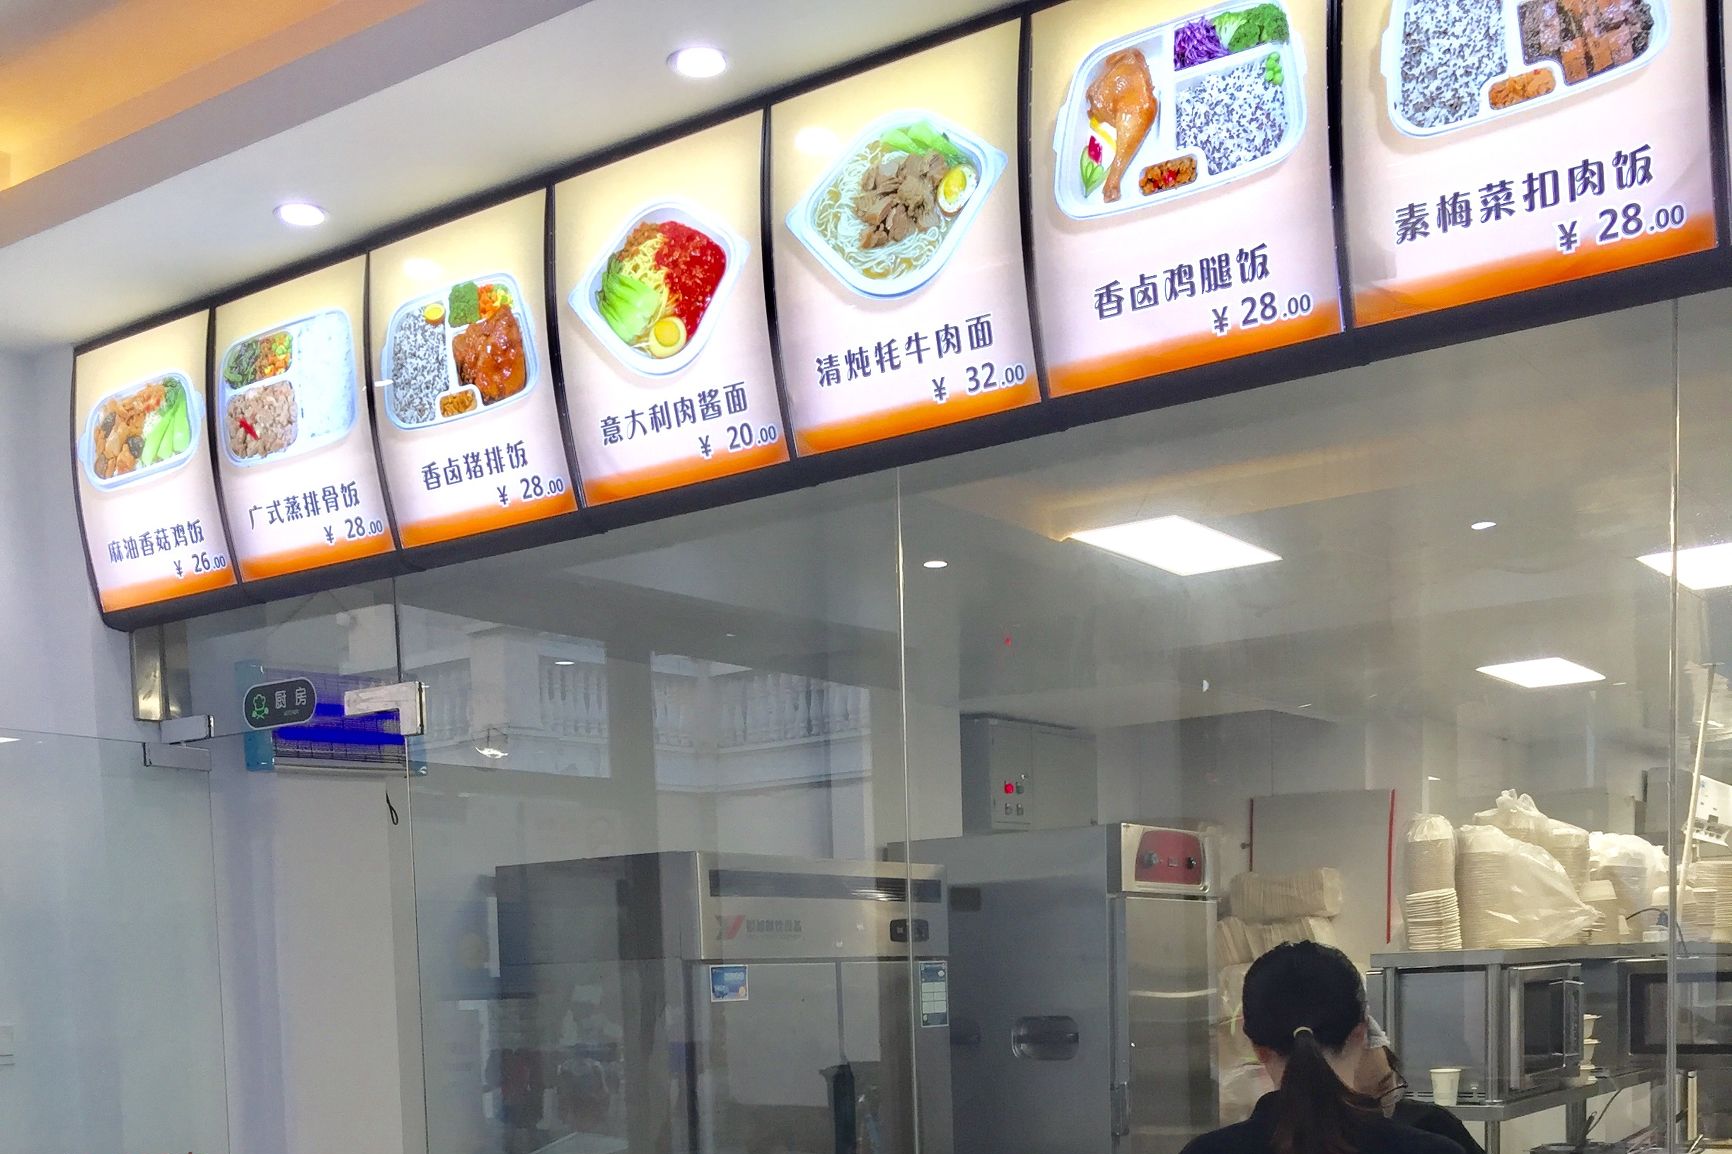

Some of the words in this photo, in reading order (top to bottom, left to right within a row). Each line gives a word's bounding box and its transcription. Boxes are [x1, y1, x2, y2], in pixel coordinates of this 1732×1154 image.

[1395, 143, 1654, 245] 素梅菜扣肉饭
[1598, 201, 1686, 243] 28.00
[1093, 242, 1271, 320] 香卤鸡腿饭
[1240, 290, 1312, 327] 28.00
[815, 312, 994, 387] 清炖牦牛肉面
[967, 362, 1026, 394] 32.00
[599, 381, 749, 447] 意大利肉酱面
[727, 422, 778, 451] 20.00
[420, 440, 529, 491] 香卤猪排饭
[248, 480, 361, 529] 广式蒸排骨饭
[521, 476, 565, 500] 28.00
[107, 518, 205, 563] 麻油香菇鸡饭
[345, 517, 384, 540] 28.00
[191, 552, 227, 573] 26.00
[275, 686, 307, 709] 厨房
